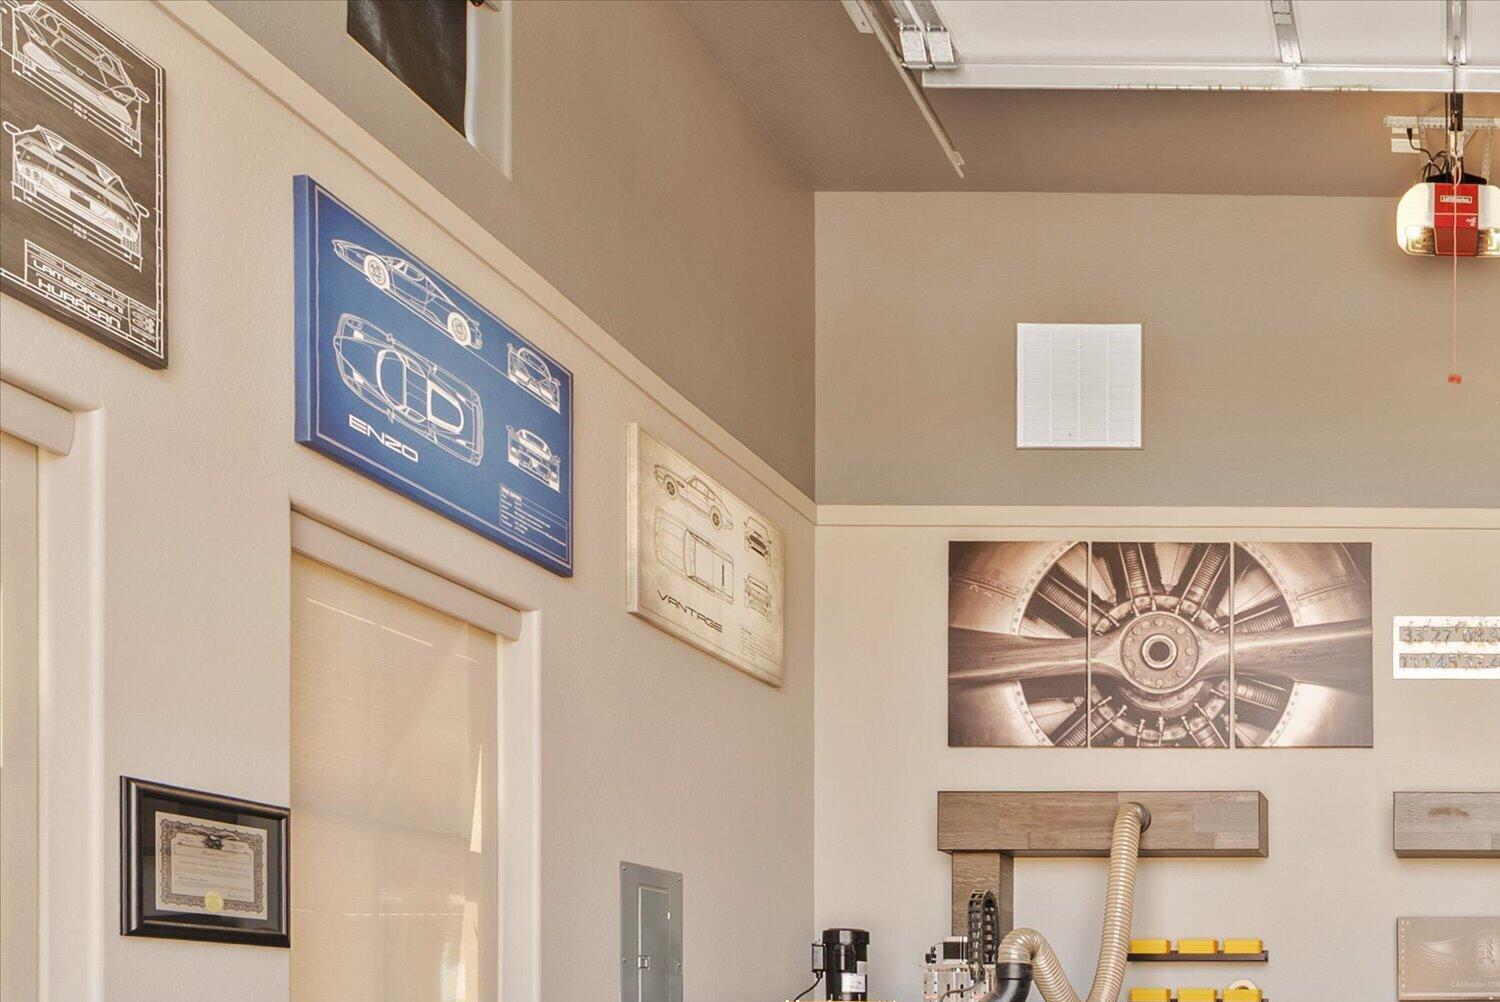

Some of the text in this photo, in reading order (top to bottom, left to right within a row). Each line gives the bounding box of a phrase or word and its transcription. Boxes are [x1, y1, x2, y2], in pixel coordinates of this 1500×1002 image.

[33, 259, 124, 314] LAMBORGHINI
[348, 414, 419, 463] ENZO
[657, 590, 724, 633] VANTAGE
